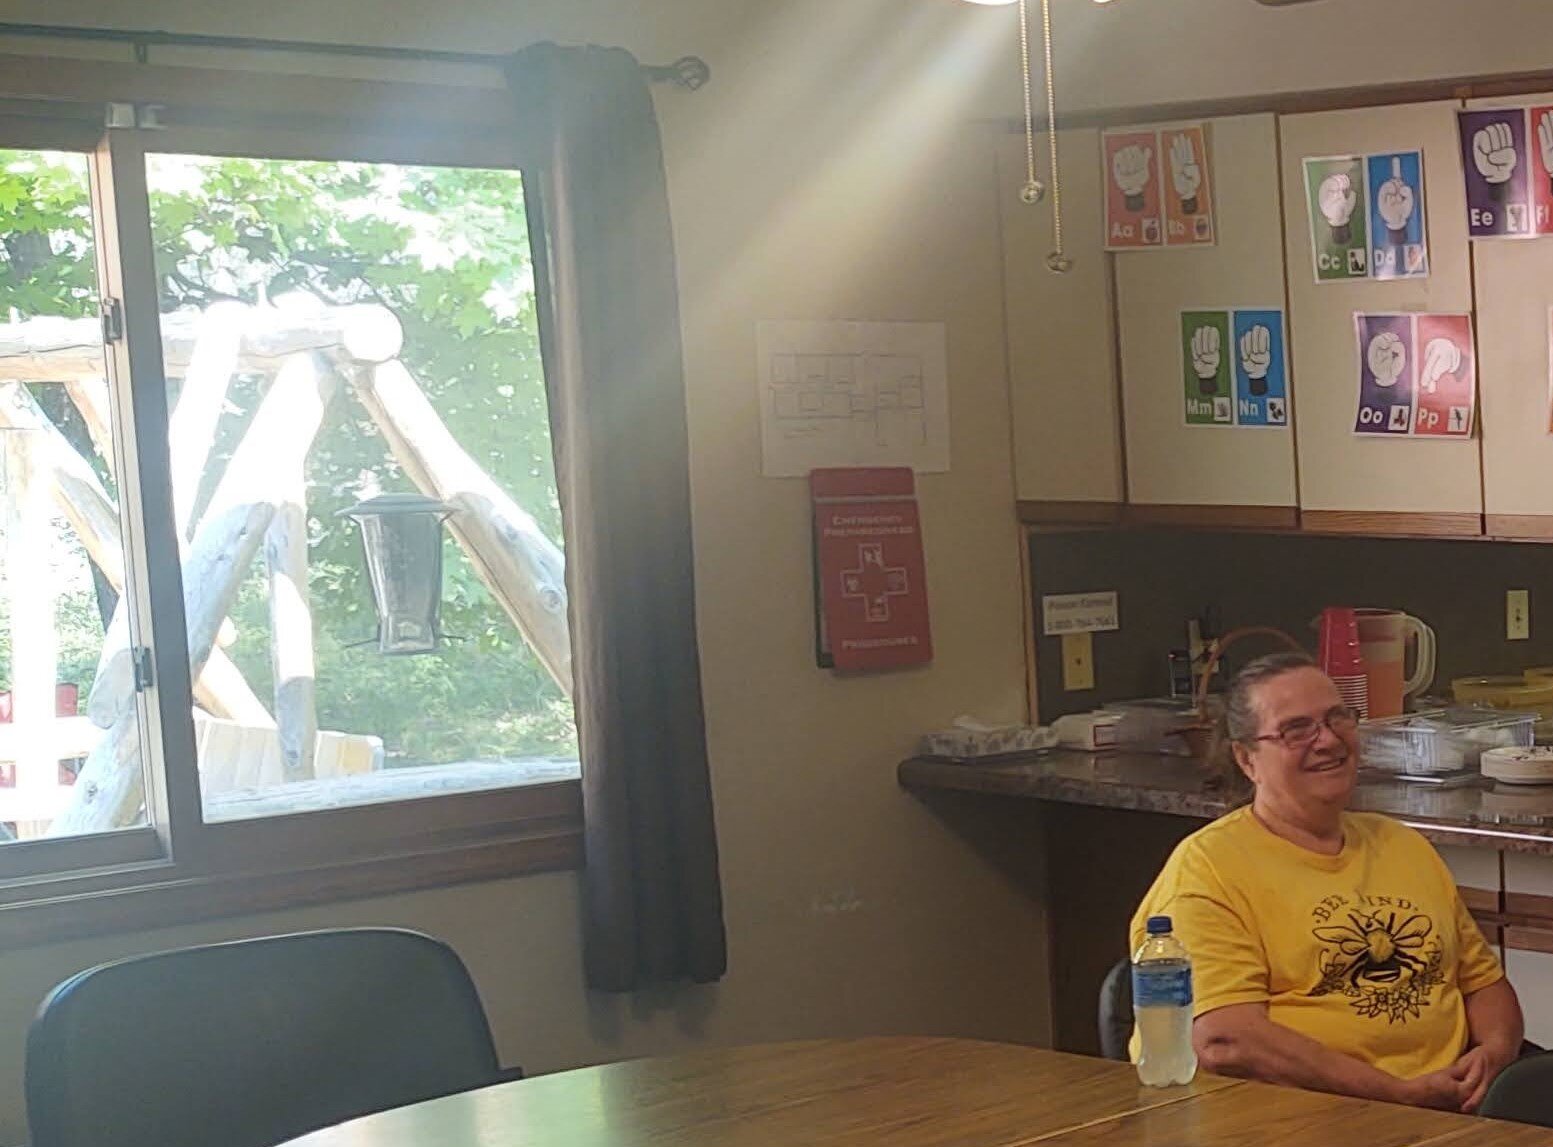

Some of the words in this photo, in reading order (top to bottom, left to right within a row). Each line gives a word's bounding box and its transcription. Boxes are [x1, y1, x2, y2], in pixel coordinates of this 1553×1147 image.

[1470, 208, 1493, 226] Ee
[1319, 253, 1341, 270] Cc
[1187, 399, 1213, 415] Mm
[1240, 399, 1259, 416] Nn
[1360, 407, 1384, 424] Oo
[1418, 408, 1439, 429] Pp
